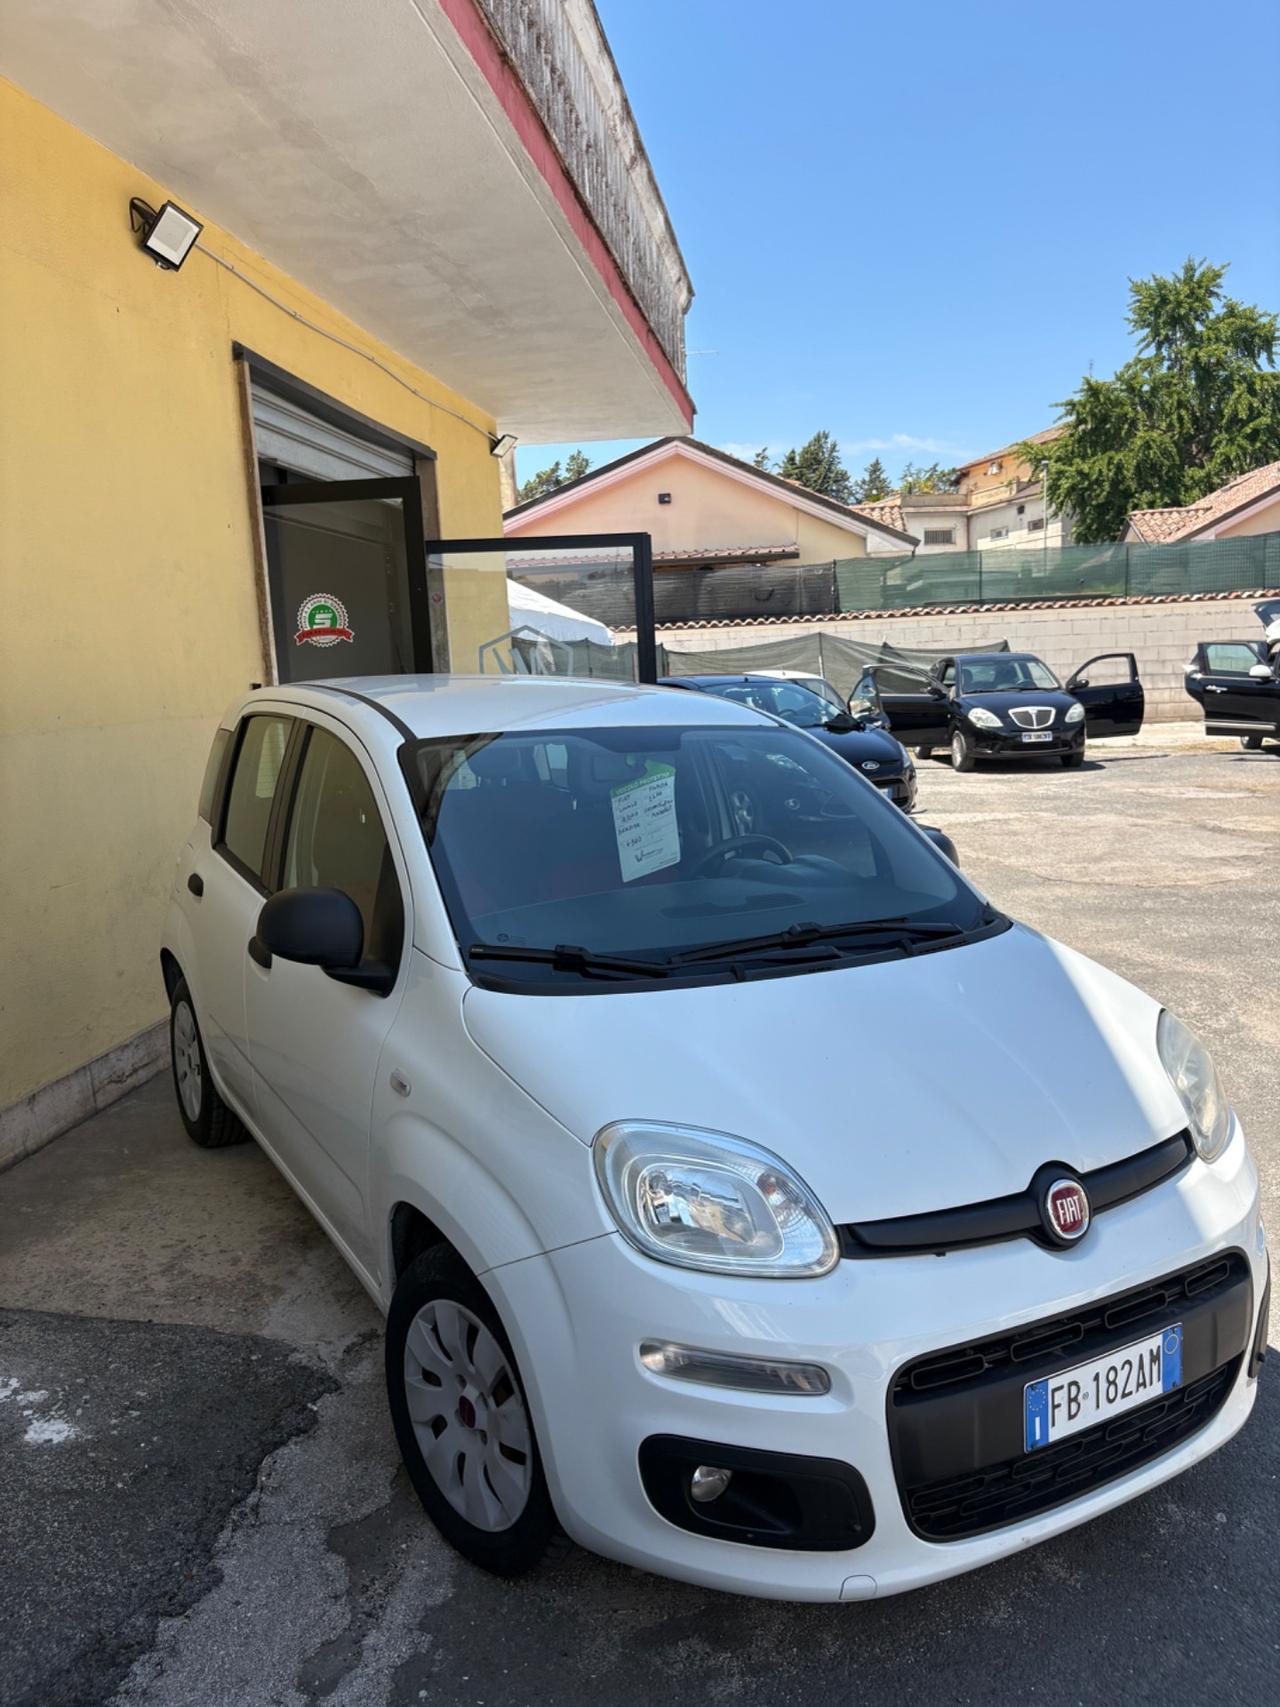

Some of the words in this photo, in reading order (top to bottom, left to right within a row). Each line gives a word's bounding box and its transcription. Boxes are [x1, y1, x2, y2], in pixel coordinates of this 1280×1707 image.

[1056, 1195, 1082, 1225] FIAT
[1051, 1380, 1081, 1428] FB
[1093, 1345, 1161, 1410] 182AM
